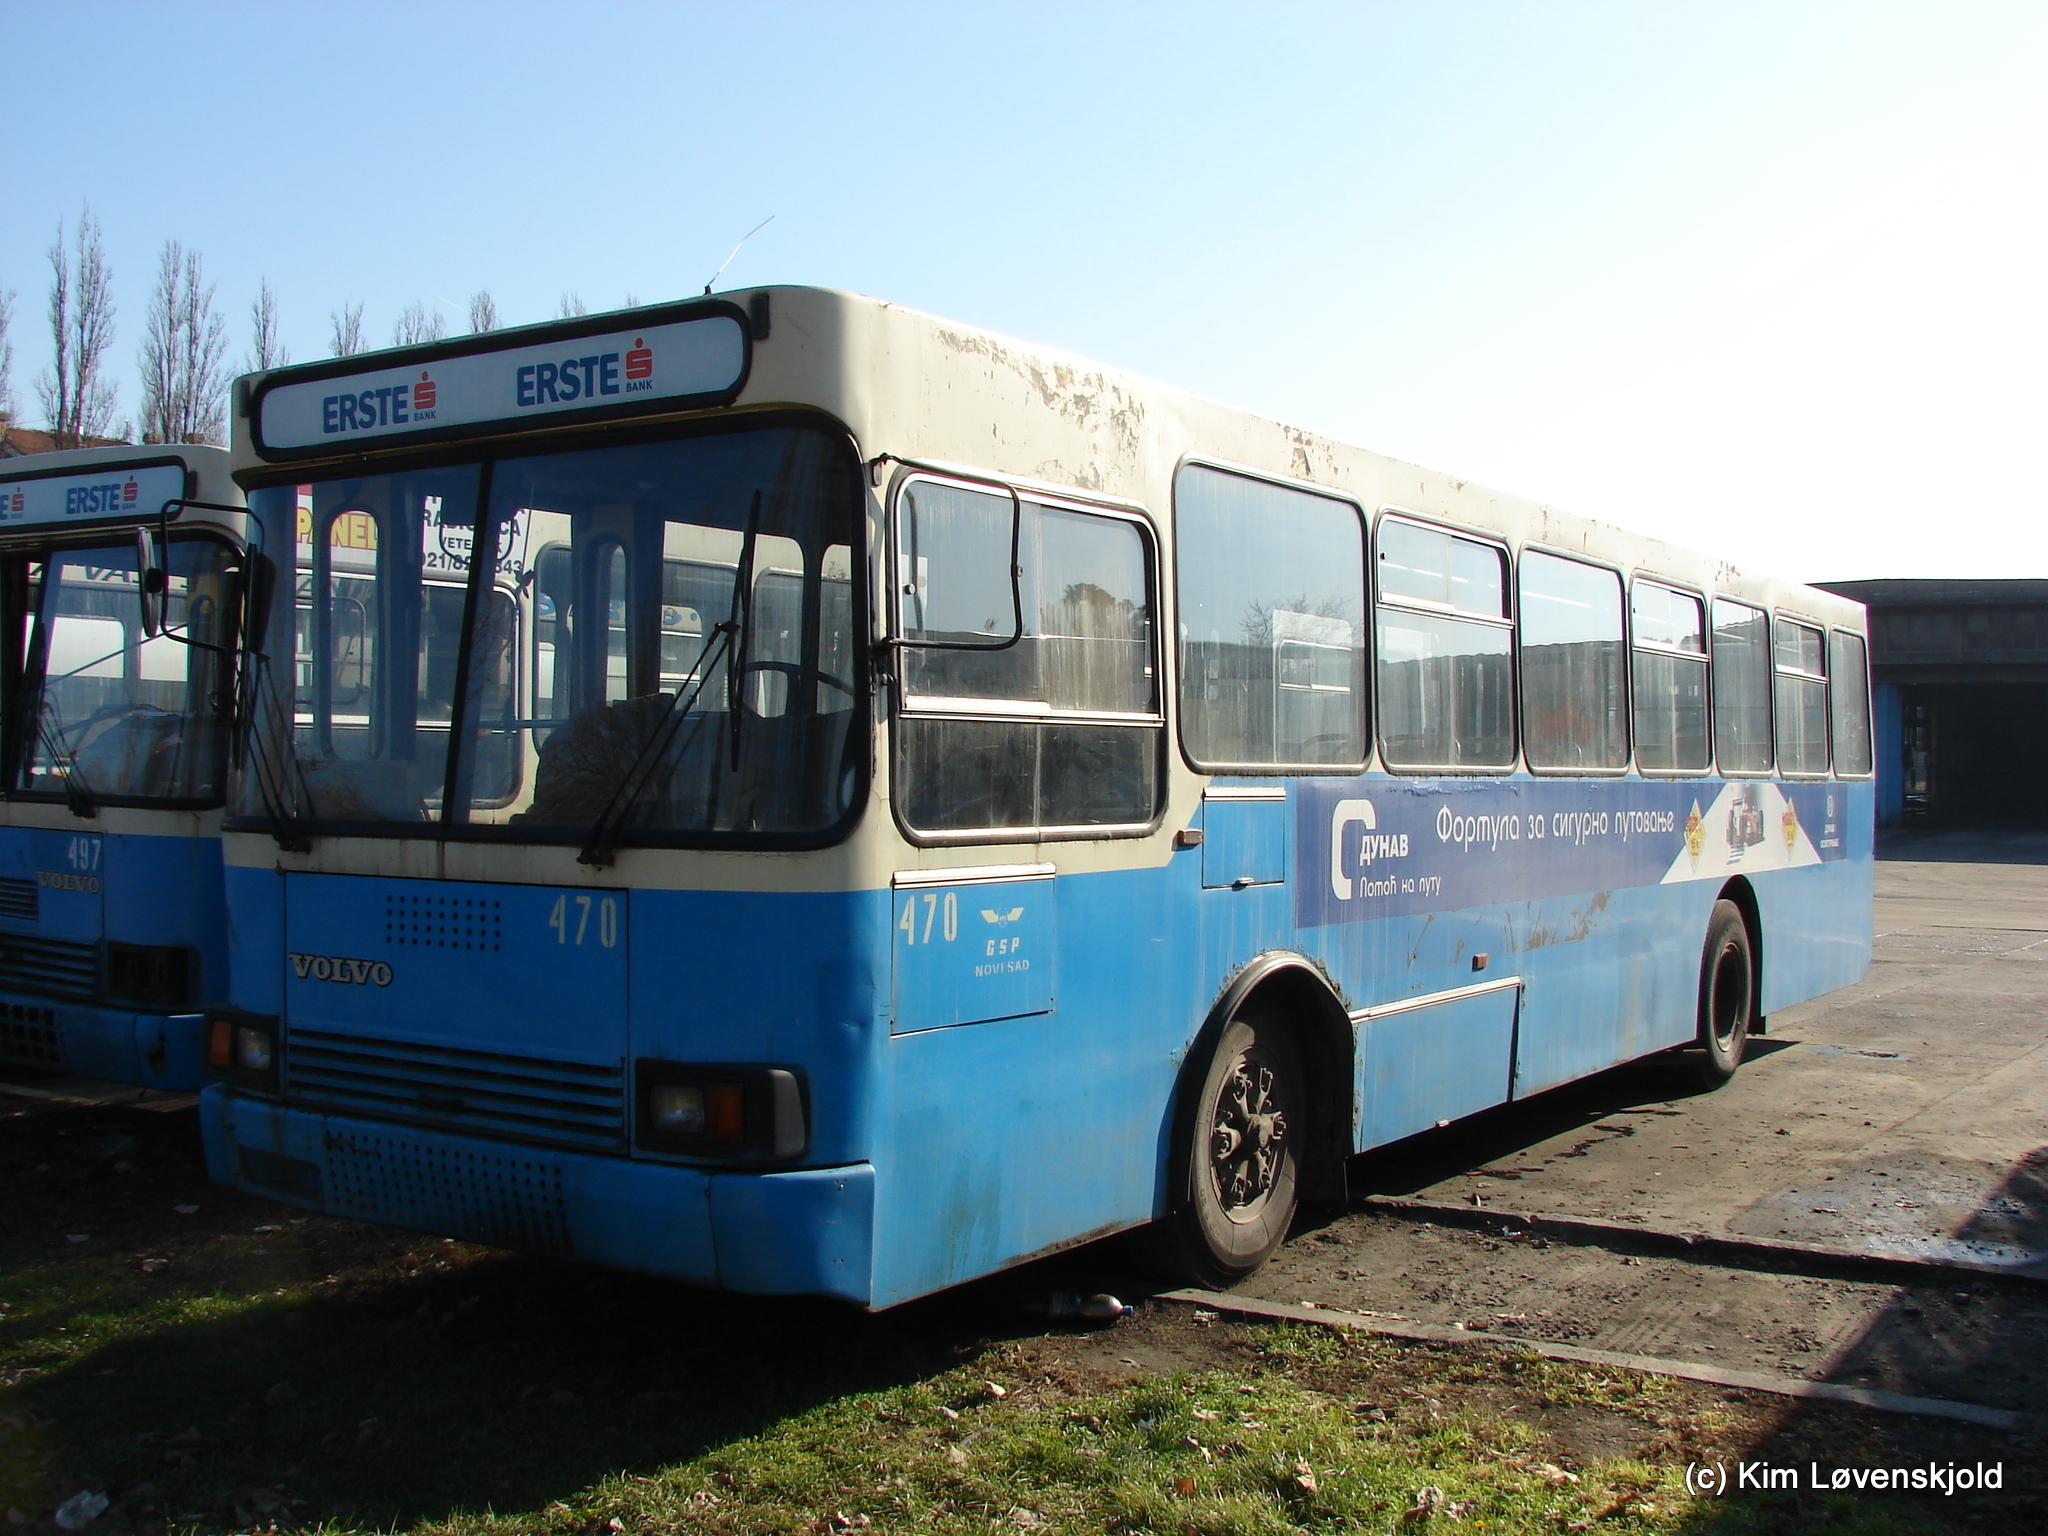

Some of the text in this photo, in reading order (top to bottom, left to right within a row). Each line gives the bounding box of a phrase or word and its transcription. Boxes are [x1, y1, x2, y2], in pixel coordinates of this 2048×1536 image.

[516, 353, 620, 408] ERSTE
[626, 379, 653, 393] BANK
[322, 384, 409, 434] ERSTE
[413, 410, 437, 423] BANK
[66, 483, 121, 514] ERSTE
[1436, 804, 1520, 852] Формула
[1527, 813, 1545, 839] за
[1552, 810, 1609, 845] сигурно
[1614, 810, 1675, 842] путовање
[68, 836, 101, 871] 497
[1359, 834, 1410, 866] ДУНАВ
[34, 869, 100, 895] VOLVO
[1402, 877, 1415, 894] на
[1419, 874, 1442, 897] путу
[549, 894, 618, 948] 470
[899, 892, 958, 945] 470
[986, 937, 1021, 956] GSP
[288, 952, 394, 987] VOLVO
[975, 959, 1030, 977] NOVI SAD
